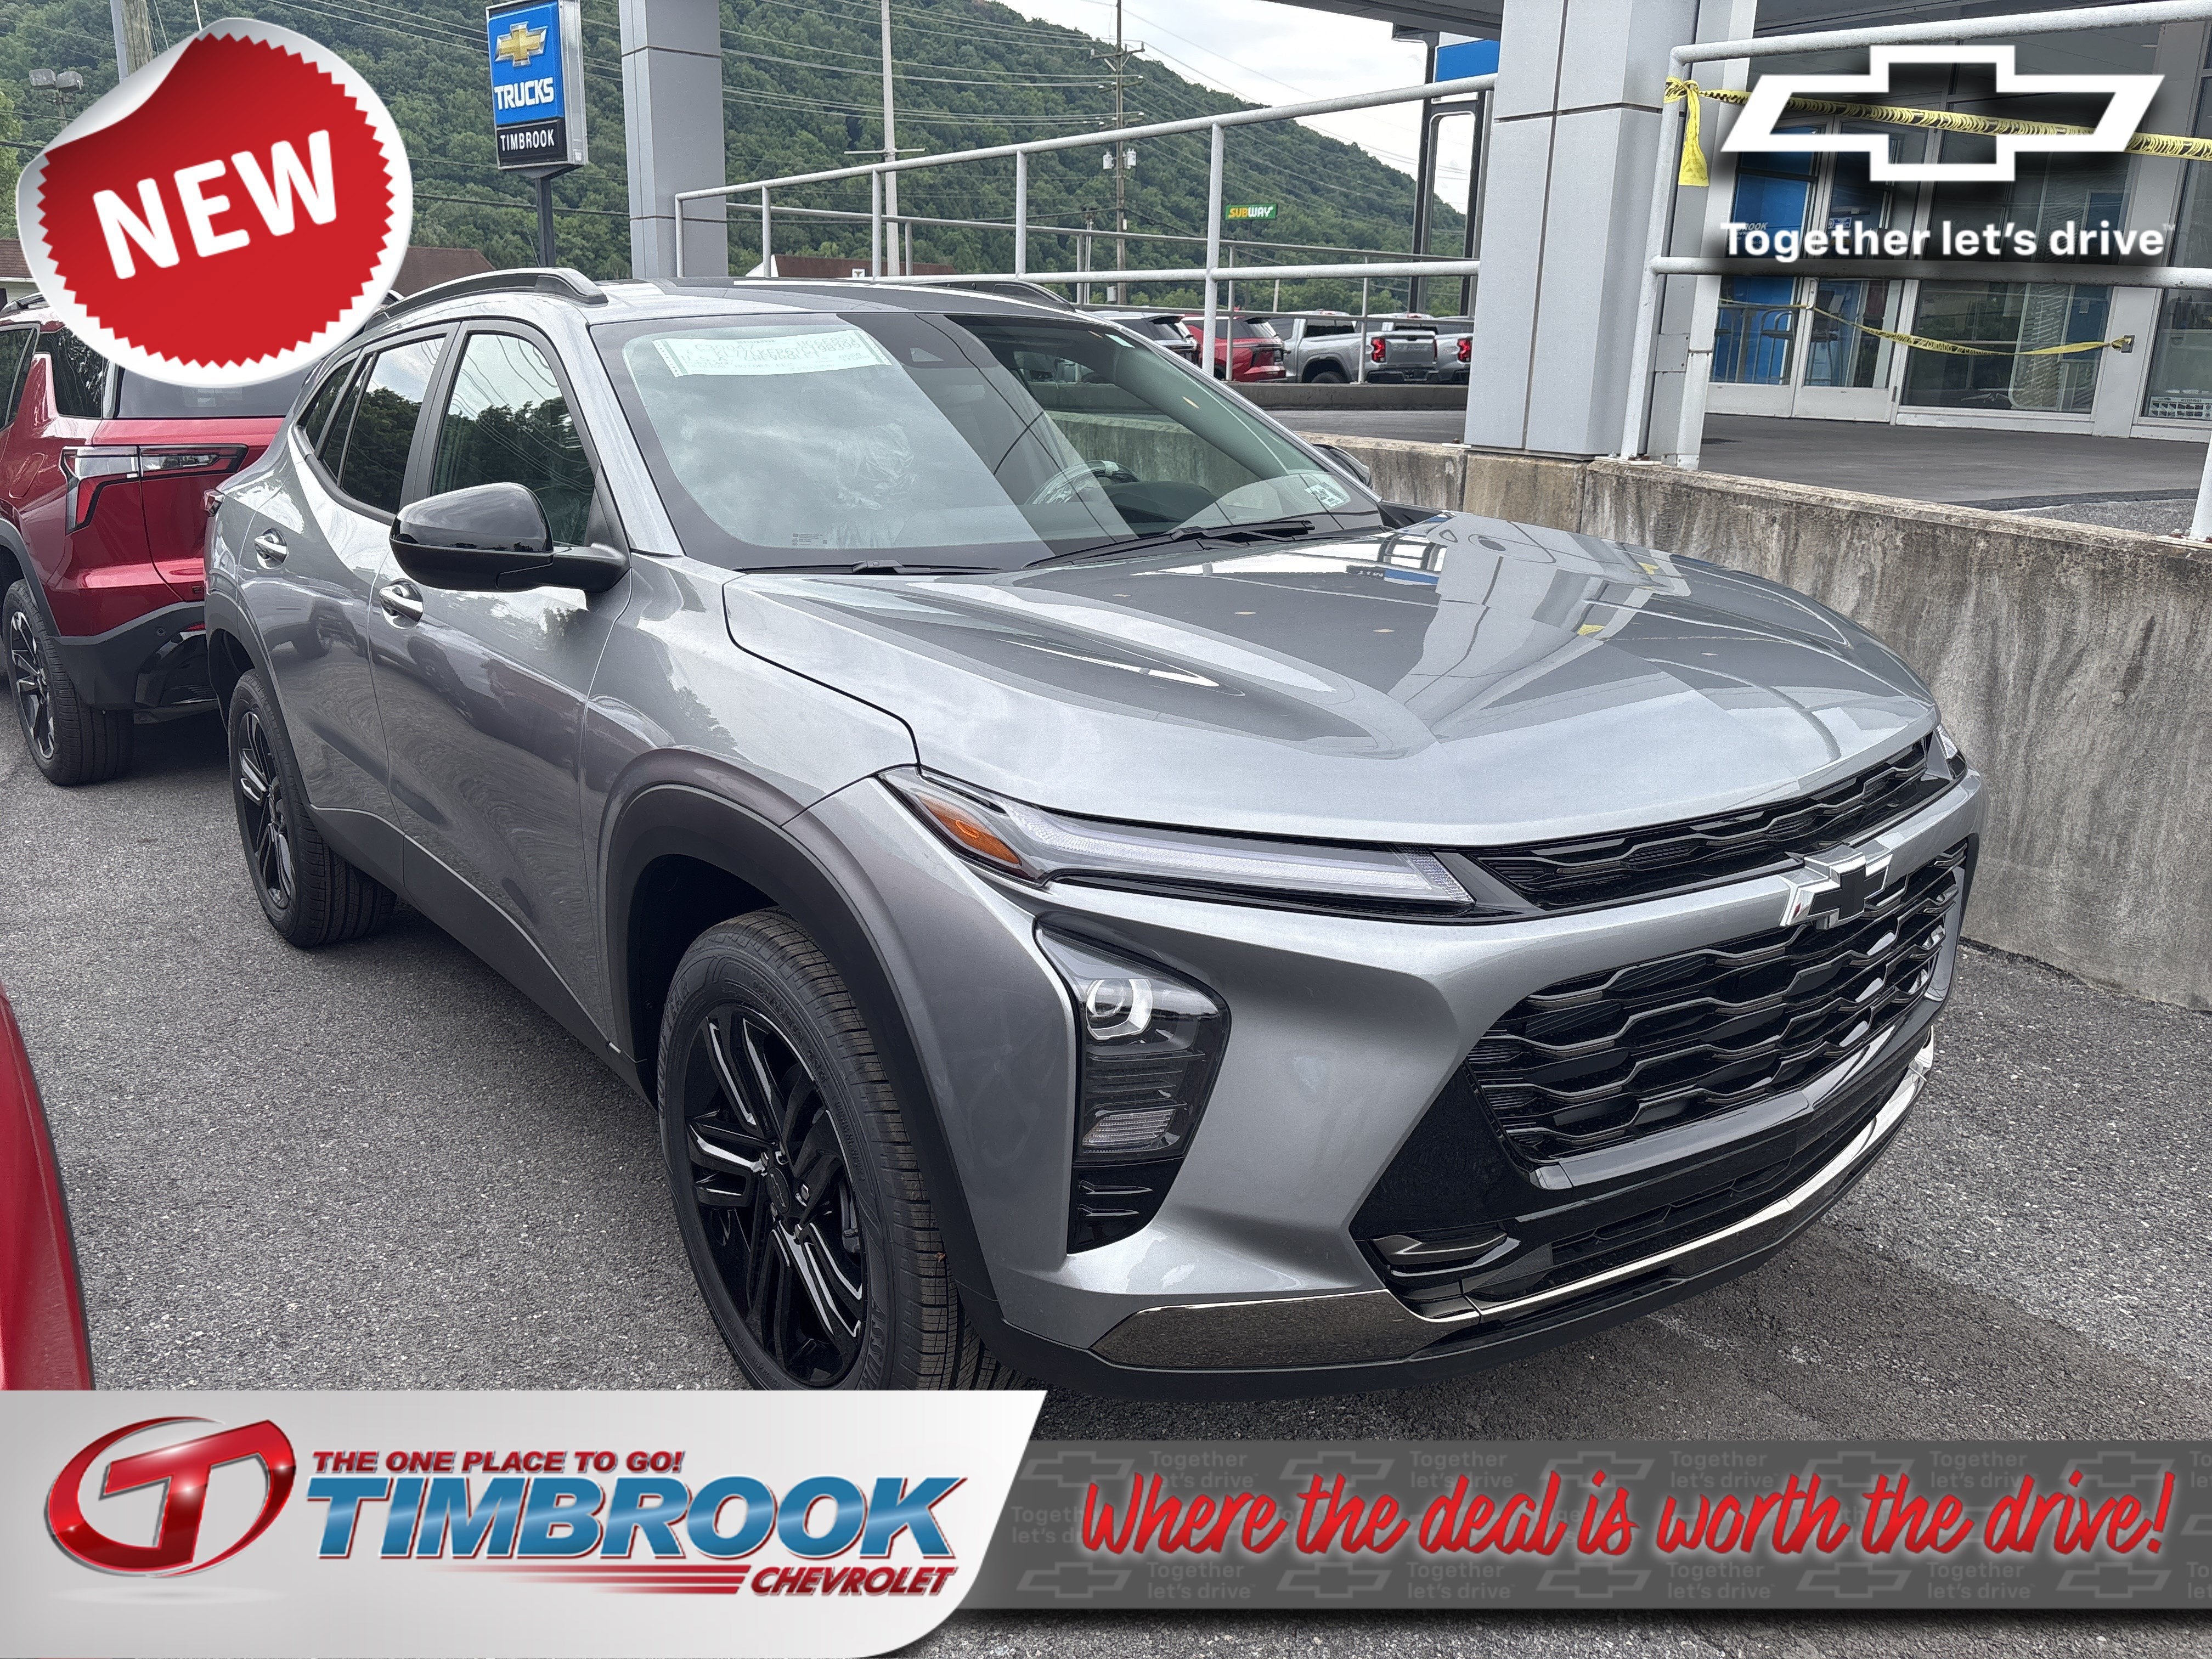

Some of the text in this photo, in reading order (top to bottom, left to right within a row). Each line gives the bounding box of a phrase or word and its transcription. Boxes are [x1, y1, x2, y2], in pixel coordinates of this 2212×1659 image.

[494, 77, 554, 110] TRUCKS
[500, 129, 555, 151] TIMBROOK
[1228, 206, 1274, 218] SUBWAY
